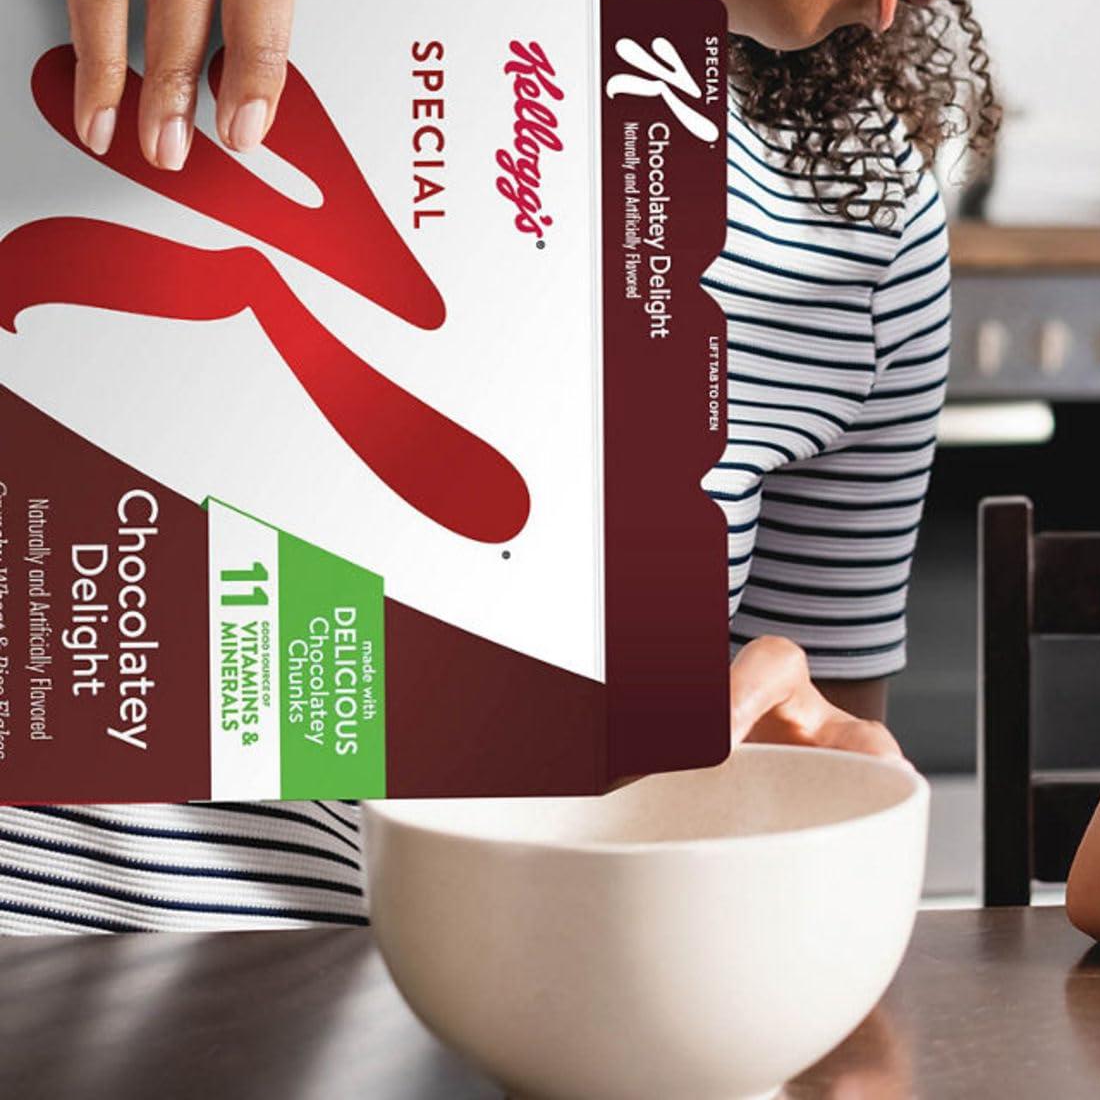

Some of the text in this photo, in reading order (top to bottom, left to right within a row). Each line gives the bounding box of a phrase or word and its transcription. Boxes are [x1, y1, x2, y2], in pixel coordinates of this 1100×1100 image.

[411, 41, 446, 229] SPECIAL
[495, 40, 565, 239] Kellogg's
[606, 37, 719, 142] K
[705, 36, 720, 105] SPECIAL
[622, 122, 643, 299] Naturally and Artificially Flavored
[643, 122, 672, 338] Chocolatey Delight
[0, 43, 531, 544] K
[709, 336, 719, 431] LIFT TAB TO OPEN
[23, 499, 53, 740] Naturally and Artificially Flavored
[61, 544, 109, 696] Delight
[107, 489, 159, 750] Chocolatey
[220, 561, 269, 606] 11
[220, 621, 239, 732] MINERALS
[241, 621, 259, 747] VITAMINS &
[288, 639, 309, 724] Chunks
[304, 617, 330, 745] Chocolatey
[334, 606, 358, 755] DELICIOUS
[362, 640, 377, 720] made with
